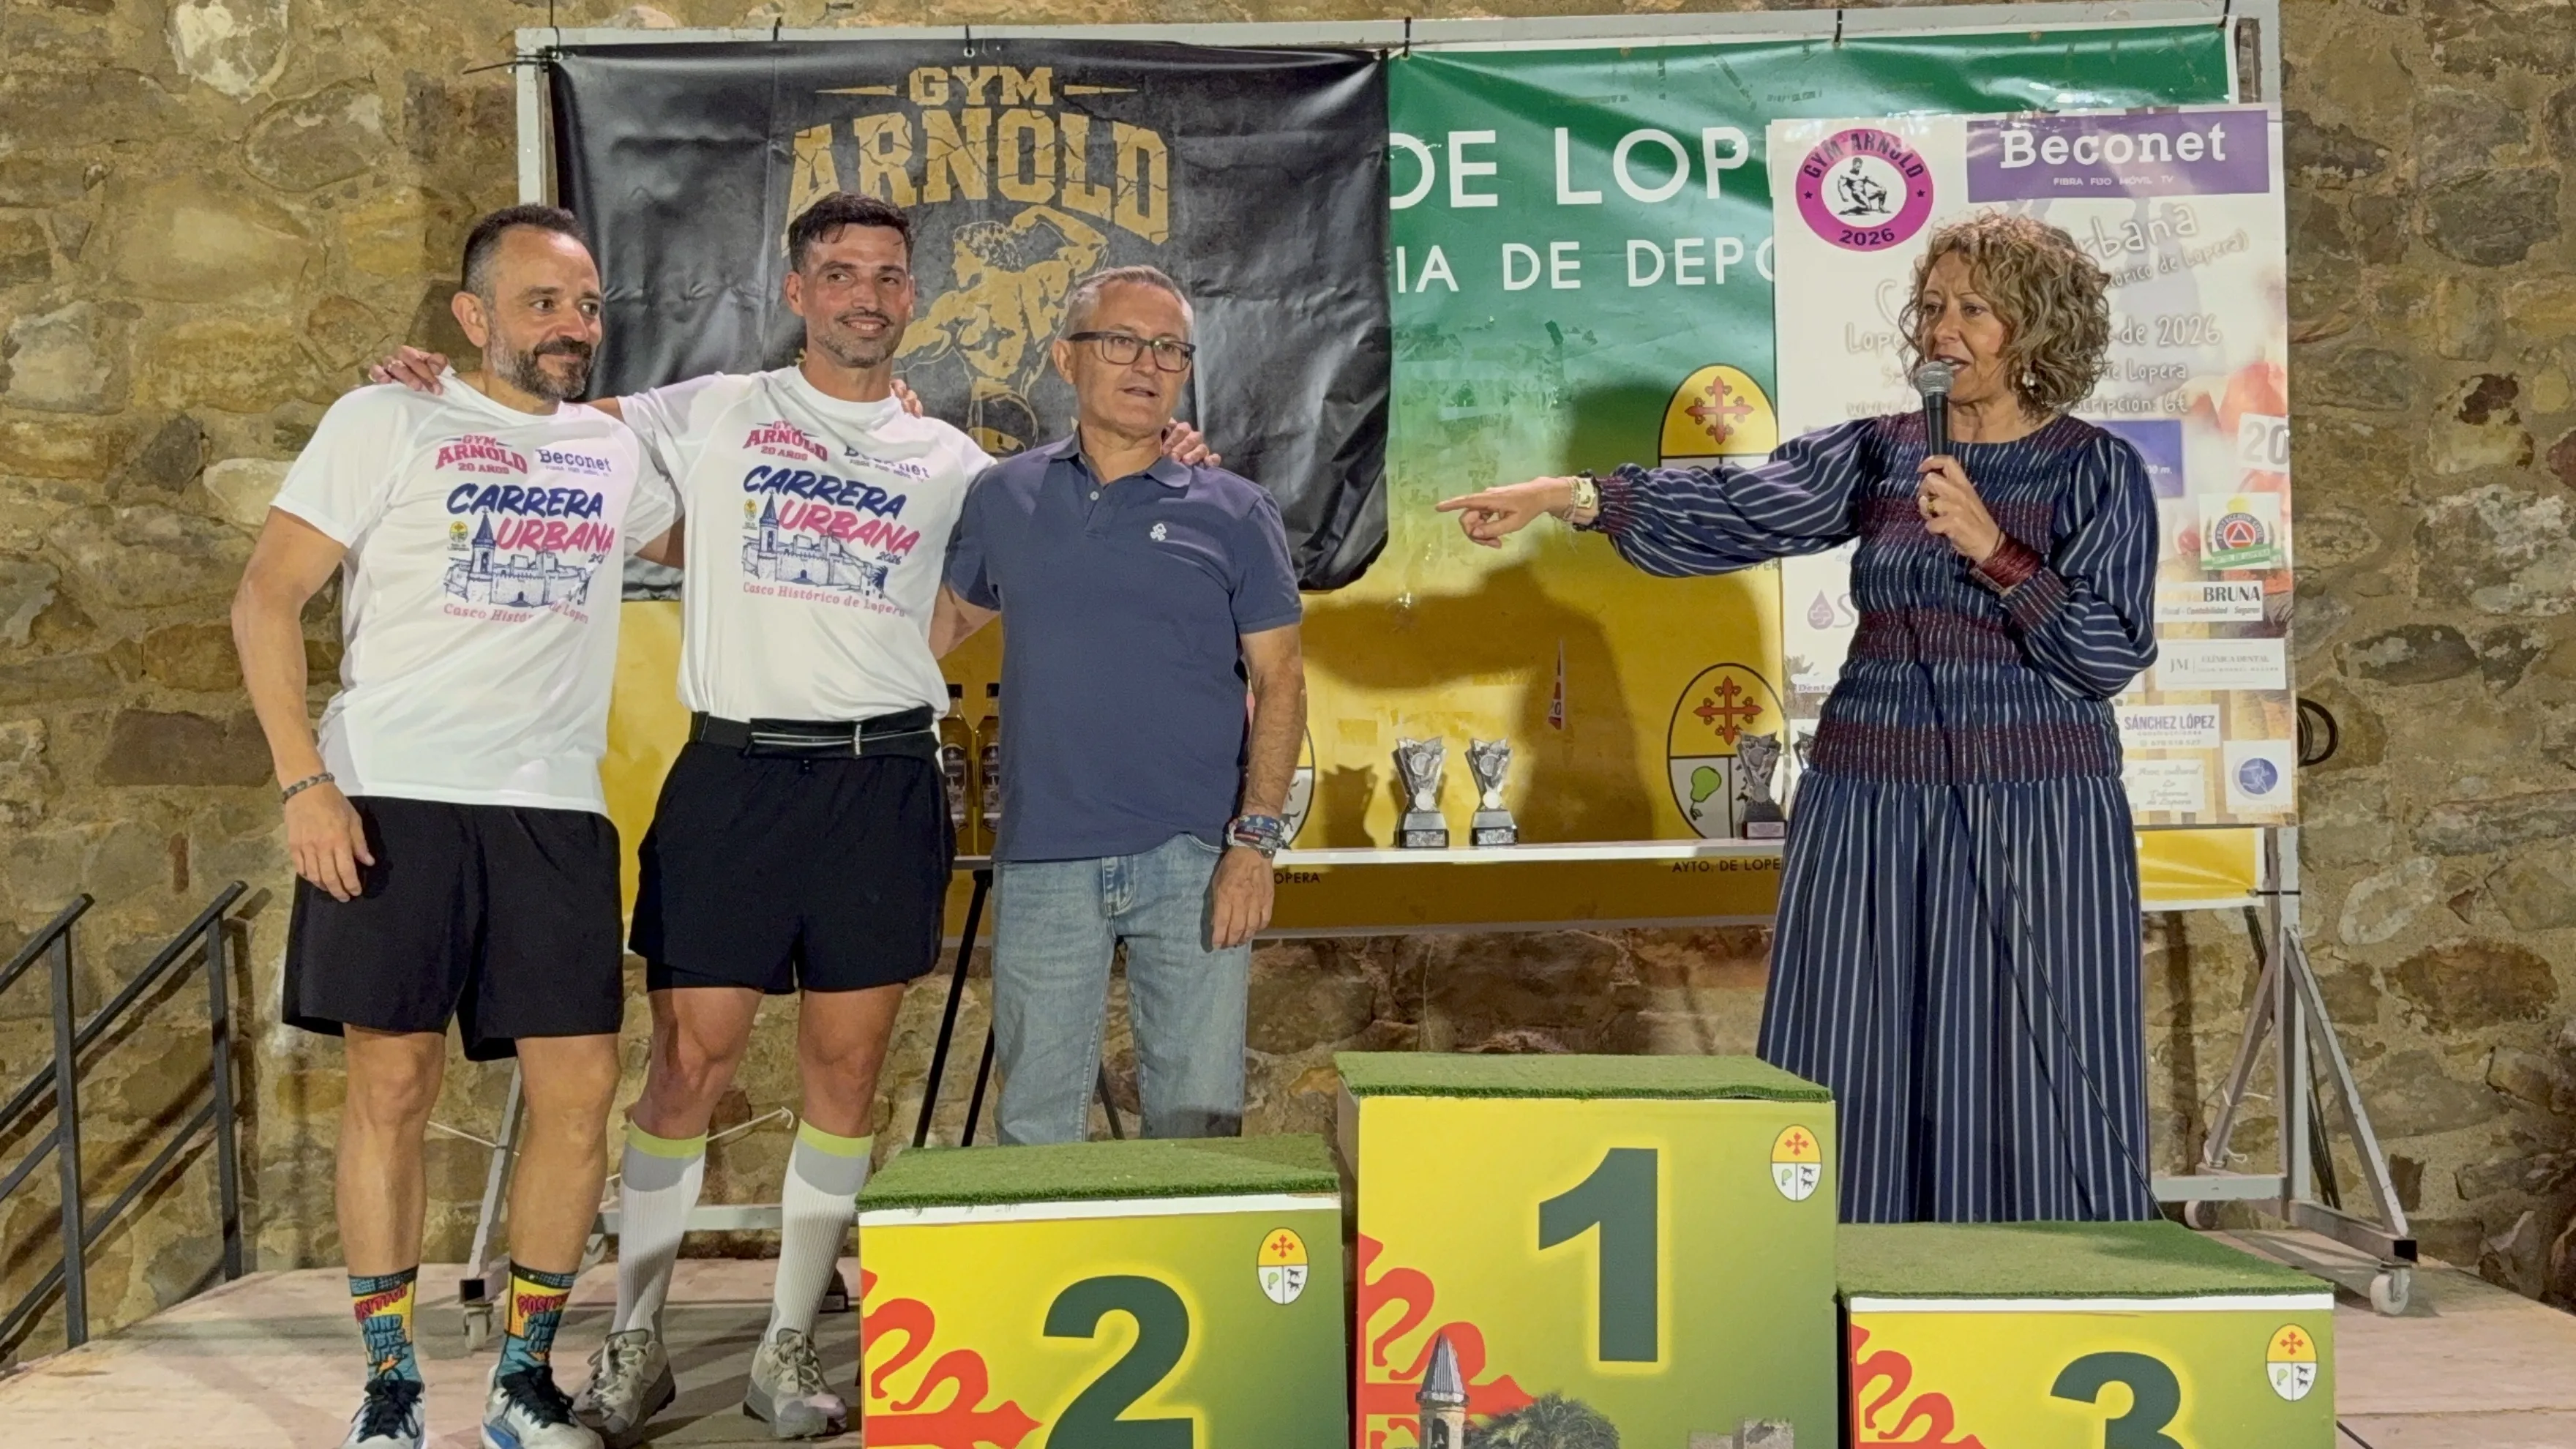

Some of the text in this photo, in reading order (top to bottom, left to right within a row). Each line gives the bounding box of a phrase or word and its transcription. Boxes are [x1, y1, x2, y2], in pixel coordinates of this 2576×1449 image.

[908, 67, 1053, 105] GYM
[1802, 132, 1925, 179] GYM ARNOLD
[1999, 122, 2226, 168] Beconet
[781, 107, 1169, 258] ARNOLD
[1390, 127, 1774, 209] DE LOP
[2053, 176, 2083, 187] FIBRA
[2160, 175, 2174, 184] TV
[1838, 228, 1895, 246] 2026
[2077, 202, 2199, 260] rbana
[1502, 242, 1581, 291] DE
[2160, 255, 2179, 274] de
[1847, 315, 2223, 357] Lope de 2026
[2127, 359, 2188, 383] Lopera
[435, 444, 528, 474] ARNOLD
[535, 449, 612, 472] Beconet
[743, 429, 828, 462] ARNOLD
[760, 446, 776, 455] 20
[458, 463, 476, 472] 20
[446, 483, 603, 519] CARRERA
[743, 465, 907, 520] CARRERA
[495, 517, 615, 554] URBANA
[778, 499, 921, 556] URBANA
[875, 551, 902, 565] 2026
[443, 602, 487, 618] Casco
[743, 582, 906, 618] Casco Histórico de Lopera
[2204, 585, 2261, 602] BRUNA
[2124, 713, 2215, 730] SÁNCHEZ LÓPEZ
[1273, 872, 1321, 885] OPERA
[1671, 858, 1781, 873] AYTO. DE LOPE
[1538, 1147, 1658, 1363] 1
[1043, 1275, 1194, 1449] 2
